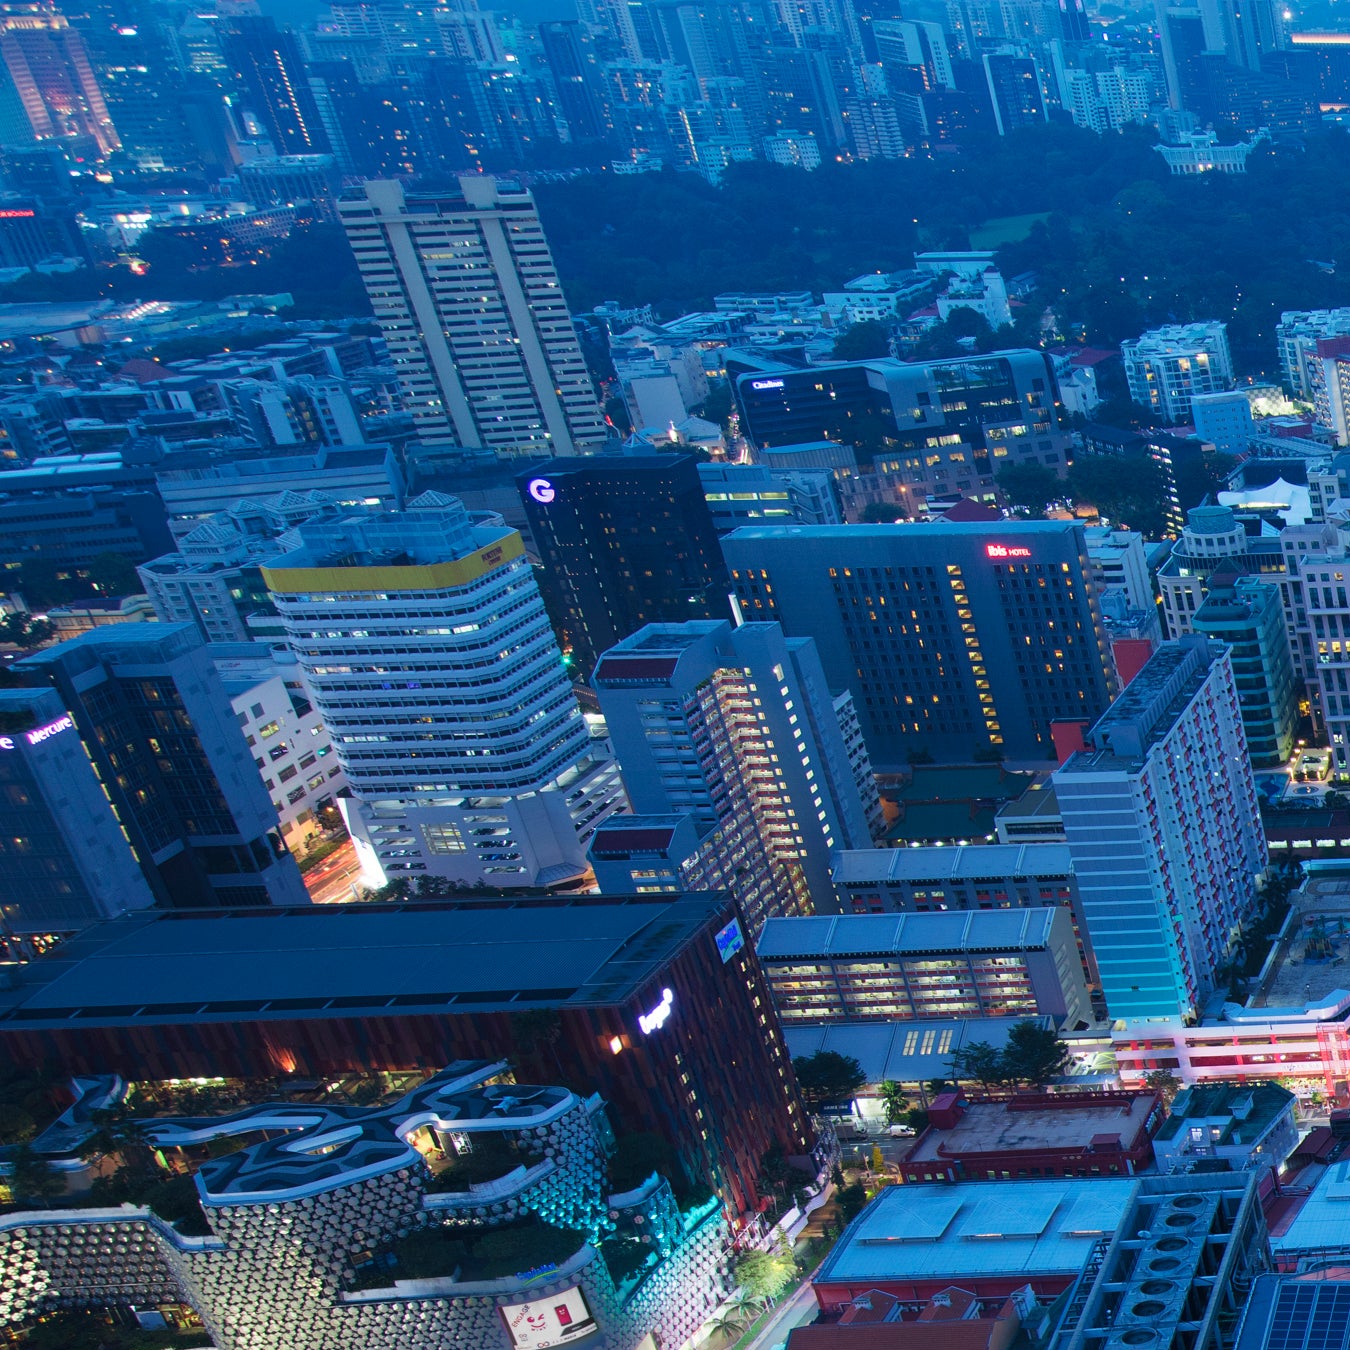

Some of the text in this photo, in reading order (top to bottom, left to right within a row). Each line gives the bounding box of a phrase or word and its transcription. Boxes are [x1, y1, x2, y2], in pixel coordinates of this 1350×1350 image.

[529, 478, 555, 503] G
[987, 545, 1031, 557] ibis HOTEL
[27, 717, 72, 745] Mercure
[511, 1304, 532, 1328] ENGAGE
